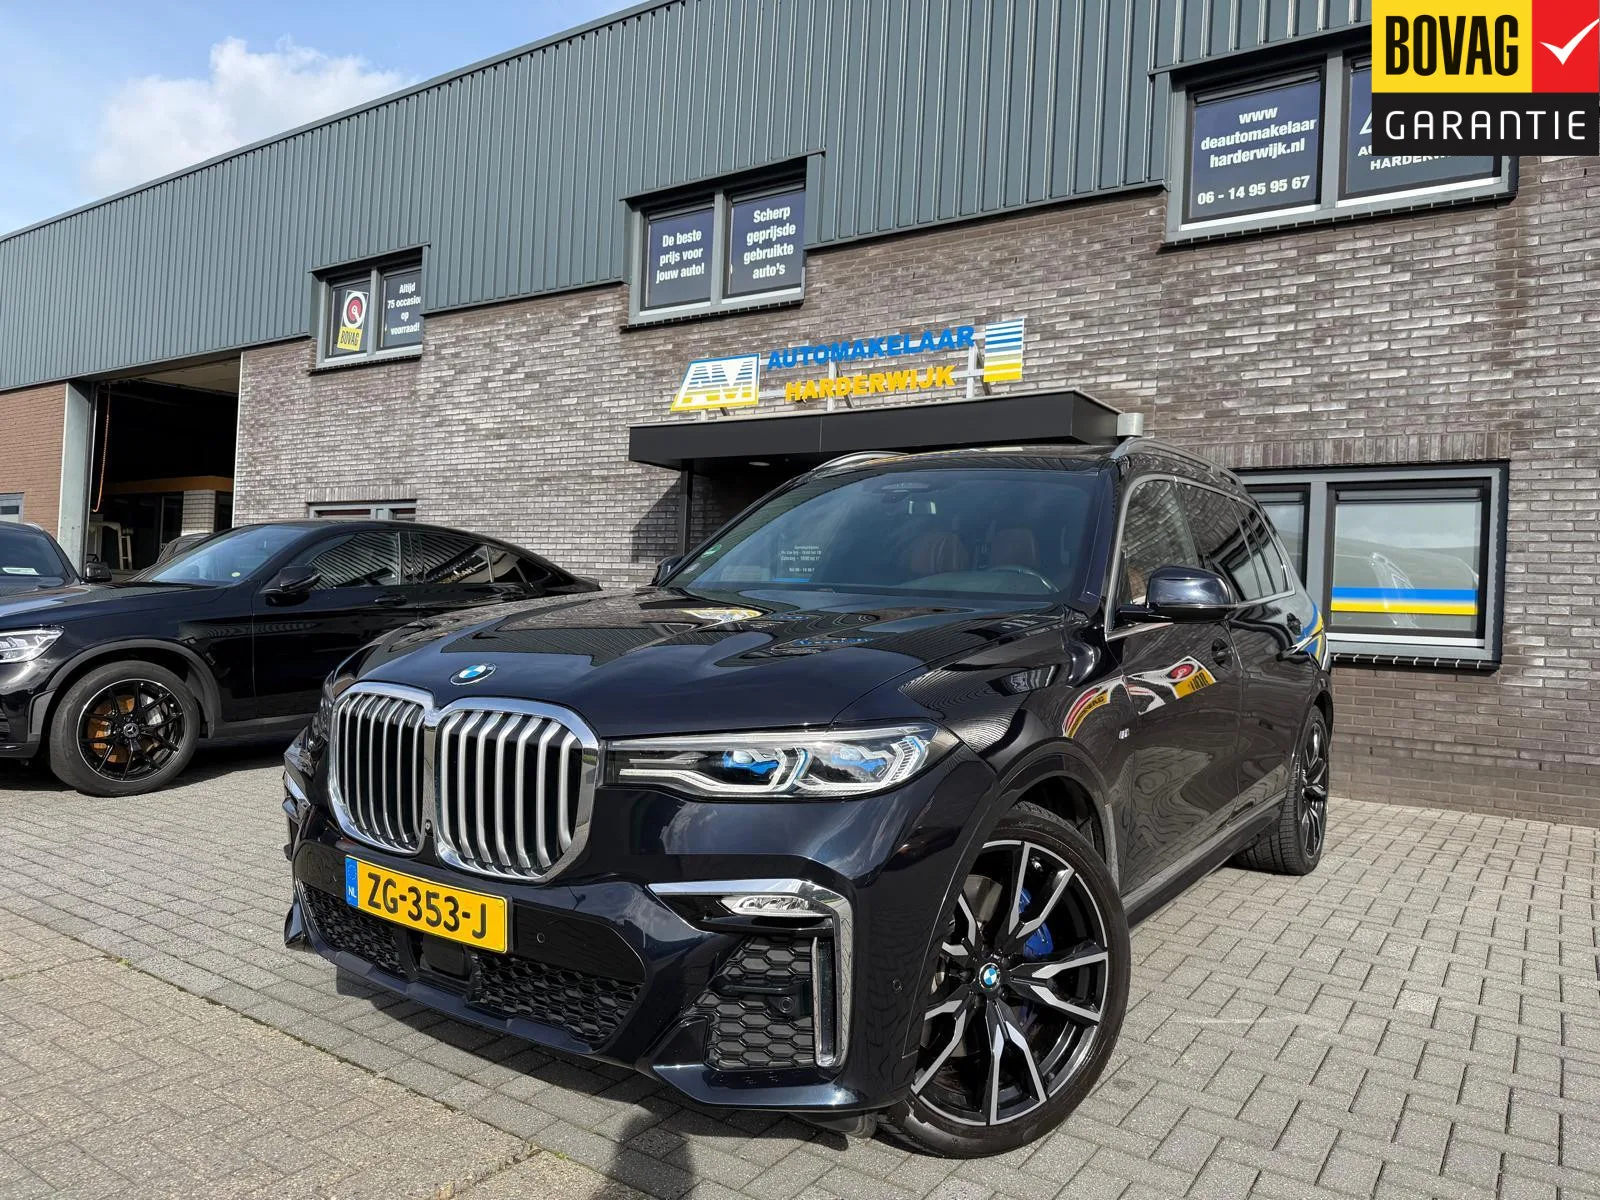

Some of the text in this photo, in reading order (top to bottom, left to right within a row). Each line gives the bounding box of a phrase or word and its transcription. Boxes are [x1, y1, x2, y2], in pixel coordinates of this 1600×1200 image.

[1239, 106, 1278, 125] www
[1200, 119, 1317, 150] deautomakelaar
[1209, 138, 1305, 168] harderwijk.nl
[1197, 191, 1215, 205] 06
[1228, 186, 1245, 200] 14
[1248, 182, 1266, 197] 95
[1270, 178, 1288, 193] 95
[1291, 175, 1311, 190] 67
[753, 206, 791, 224] Scherp
[662, 230, 702, 247] De beste
[746, 222, 796, 246] geprijsde
[659, 248, 704, 267] prijs voor
[743, 243, 794, 265] gebruikte
[656, 264, 705, 284] jouw auto!
[752, 263, 786, 280] auto's
[399, 282, 415, 294] Altijd
[387, 299, 395, 309] 75
[400, 311, 409, 322] op
[340, 330, 359, 346] BOVAG
[390, 322, 420, 335] voorraad!
[767, 325, 975, 370] AUTOMAKELAAR
[785, 365, 956, 401] HARDERWIJK
[367, 871, 487, 940] ZG-353-J
